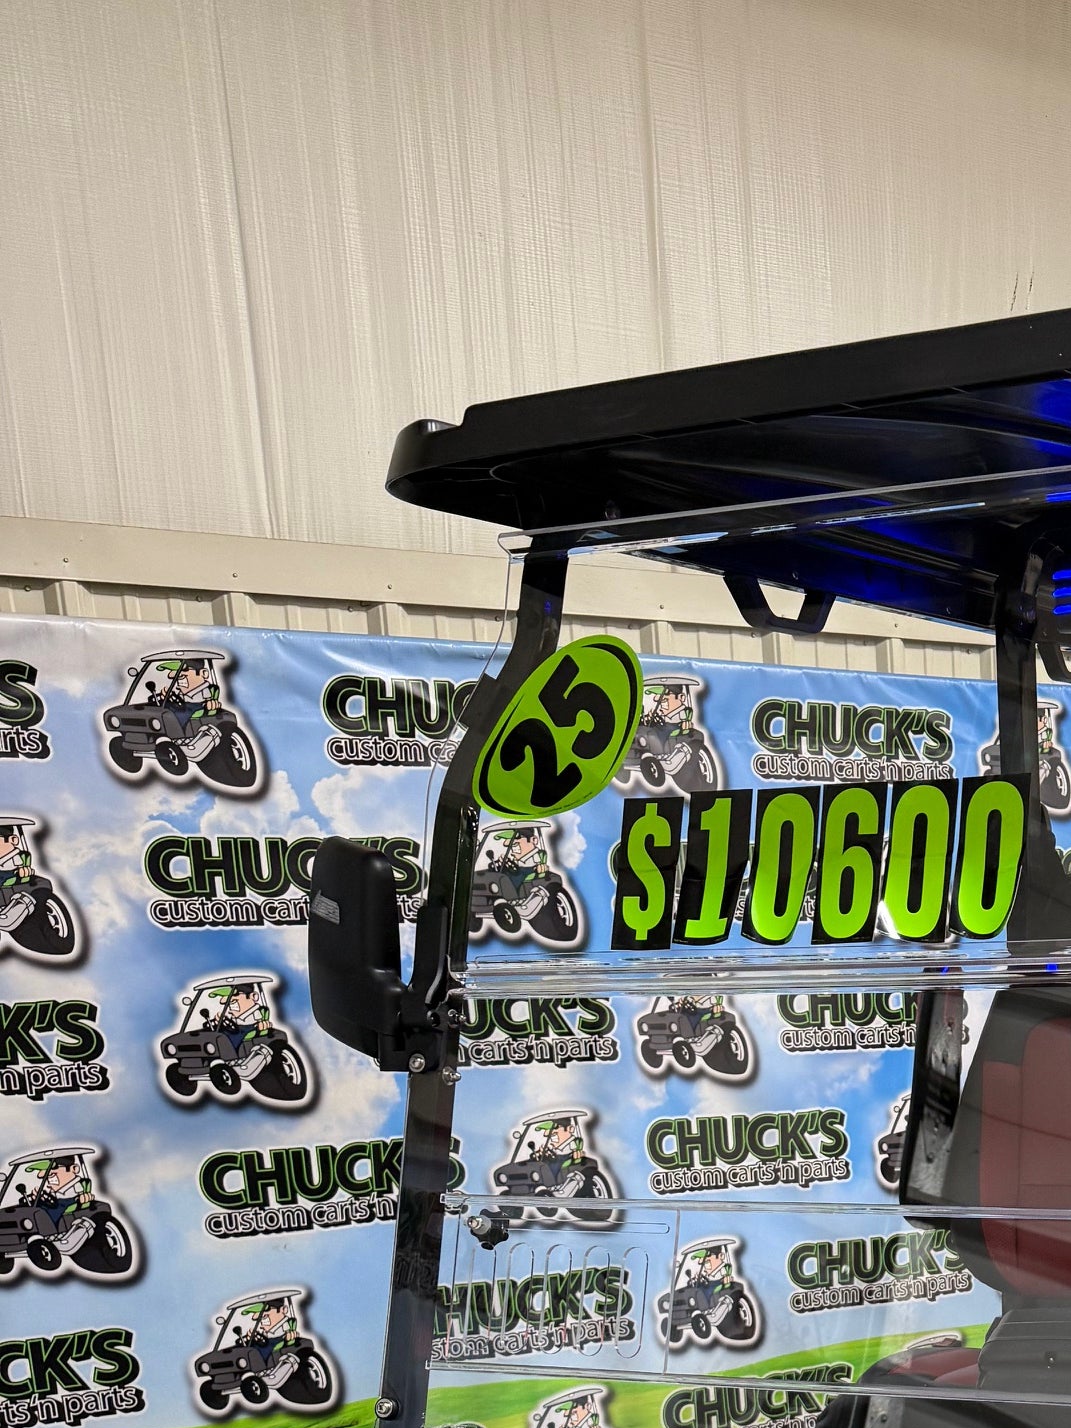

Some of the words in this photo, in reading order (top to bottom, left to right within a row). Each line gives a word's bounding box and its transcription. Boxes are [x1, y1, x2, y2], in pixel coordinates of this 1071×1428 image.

[500, 654, 616, 808] 25
[752, 699, 953, 761] CHUCK'S
[326, 737, 428, 764] custom
[753, 754, 832, 779] custom
[901, 761, 952, 780] parts
[622, 781, 1024, 940] $10600
[151, 899, 260, 924] custom
[553, 1034, 616, 1067] parts
[780, 1027, 853, 1050] custom
[24, 1062, 105, 1098] parts
[646, 1109, 849, 1170] CHUCK'S
[650, 1167, 726, 1193] custom
[799, 1157, 849, 1187] parts
[205, 1205, 310, 1237] custom
[434, 1266, 633, 1335] HUCK'S
[790, 1286, 862, 1311] custom
[927, 1272, 971, 1300] parts
[431, 1336, 491, 1361] stom
[571, 1317, 632, 1350] parts
[62, 1386, 142, 1425] parts
